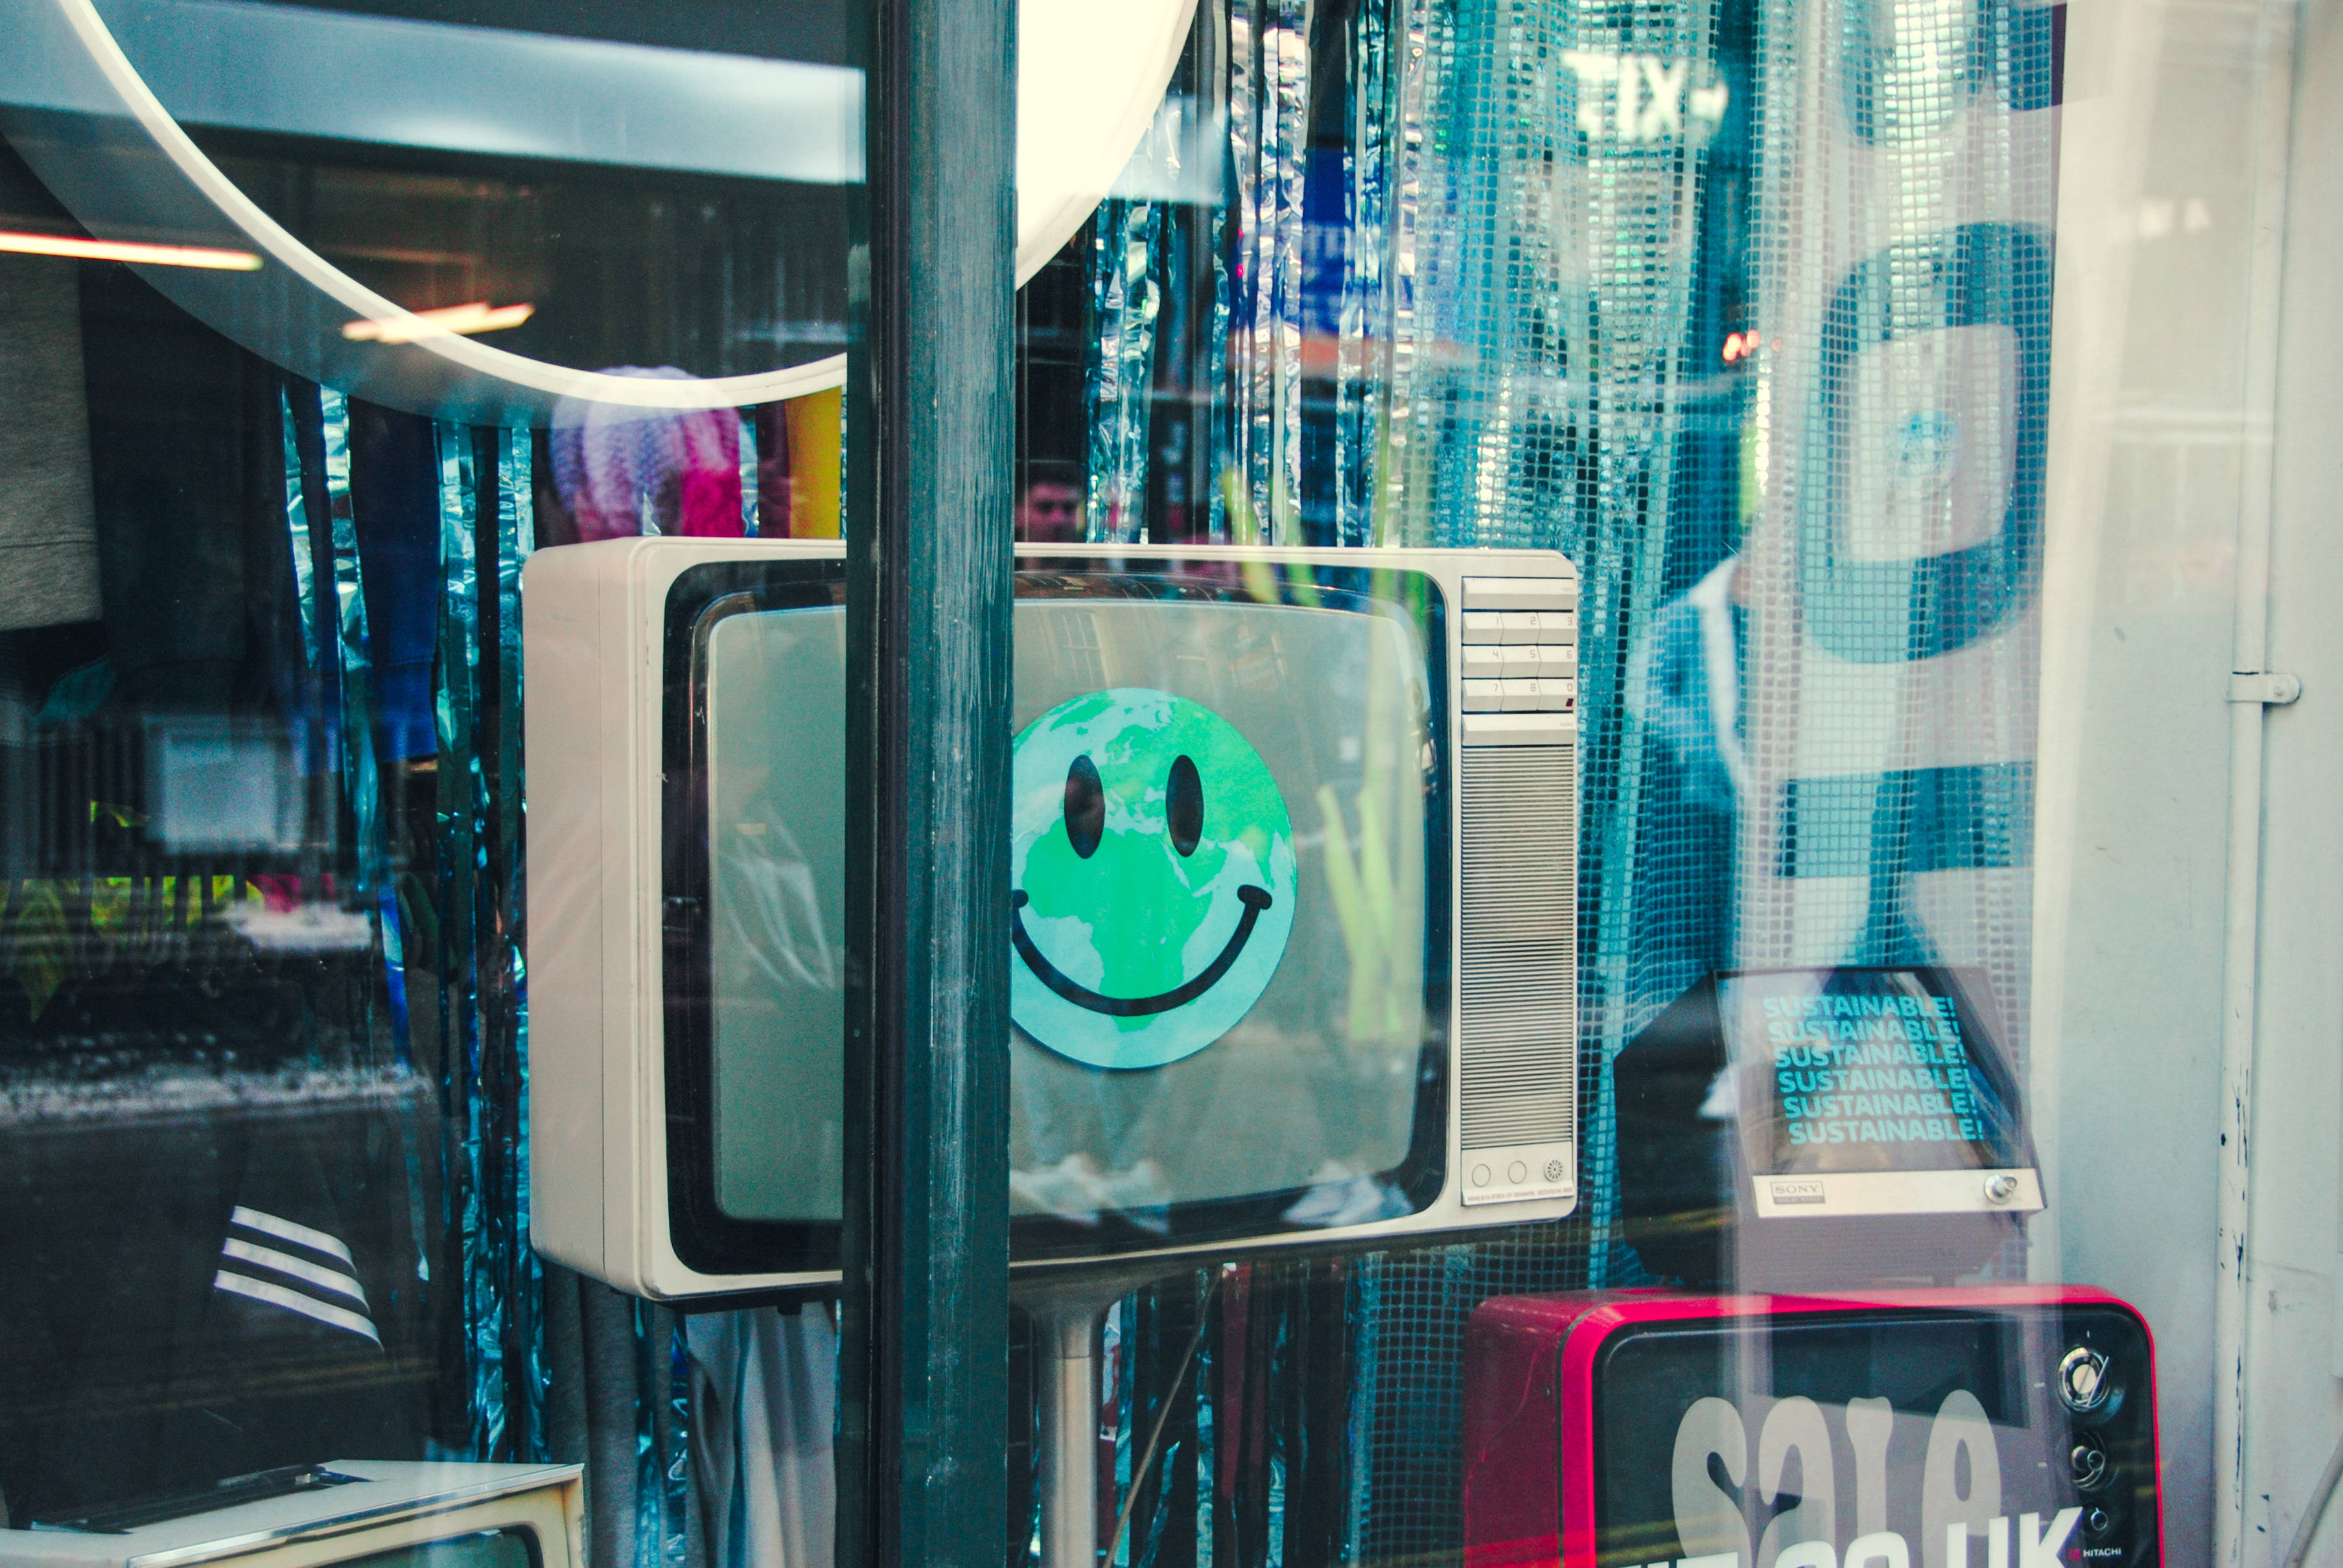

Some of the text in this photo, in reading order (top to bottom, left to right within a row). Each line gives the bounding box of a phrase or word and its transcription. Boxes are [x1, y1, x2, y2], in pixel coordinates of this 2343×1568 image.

[1530, 617, 1535, 625] 2
[1567, 617, 1572, 625] 3
[1763, 995, 1956, 1018] SUSTAINABLE!
[1768, 1019, 1961, 1042] SUSTAINABLE!
[1774, 1043, 1967, 1068] SUSTAINABLE!
[1778, 1067, 1972, 1093] SUSTAINABLE!
[1784, 1092, 1977, 1118] SUSTAINABLE!
[1788, 1118, 1984, 1144] SUSTAINABLE!
[1775, 1184, 1818, 1193] SONY
[2083, 1547, 2121, 1557] HITACHI
